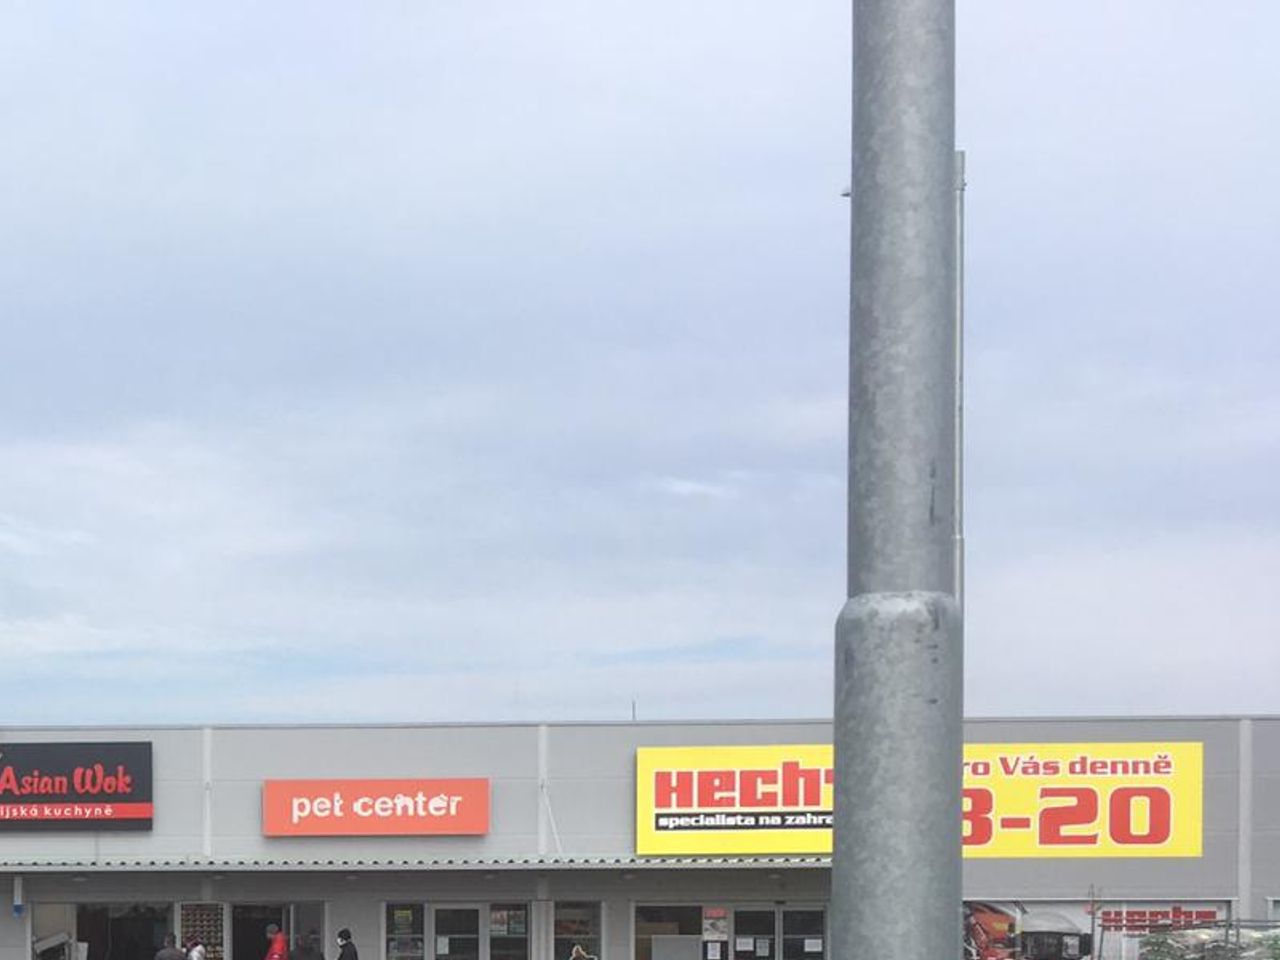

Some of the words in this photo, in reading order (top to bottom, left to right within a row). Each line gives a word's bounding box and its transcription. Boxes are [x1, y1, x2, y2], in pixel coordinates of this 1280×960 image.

[999, 755, 1061, 776] Vás
[1069, 755, 1172, 776] denně
[73, 763, 133, 794] Wok
[44, 805, 114, 819] kuchyně
[291, 792, 344, 824] pet
[352, 791, 463, 817] center
[658, 814, 755, 829] specialista
[759, 815, 782, 825] na
